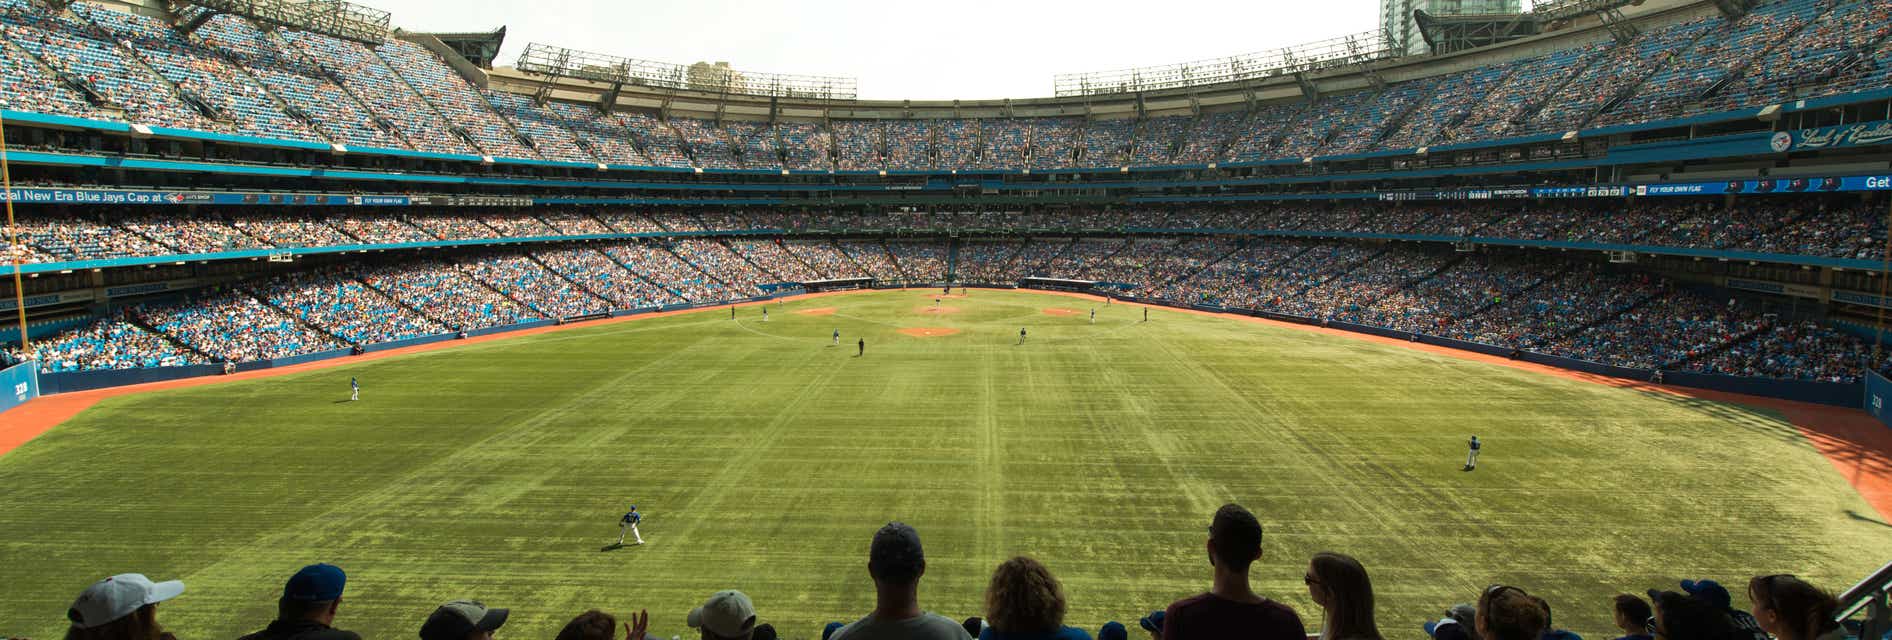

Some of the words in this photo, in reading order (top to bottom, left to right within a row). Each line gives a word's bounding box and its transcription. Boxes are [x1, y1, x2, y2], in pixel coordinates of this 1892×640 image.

[1866, 176, 1889, 188] Get
[24, 190, 51, 201] New
[55, 191, 73, 201] Era
[76, 192, 100, 202] Blue
[103, 192, 125, 203] Jays
[127, 192, 149, 204] Cap
[152, 193, 162, 202] at
